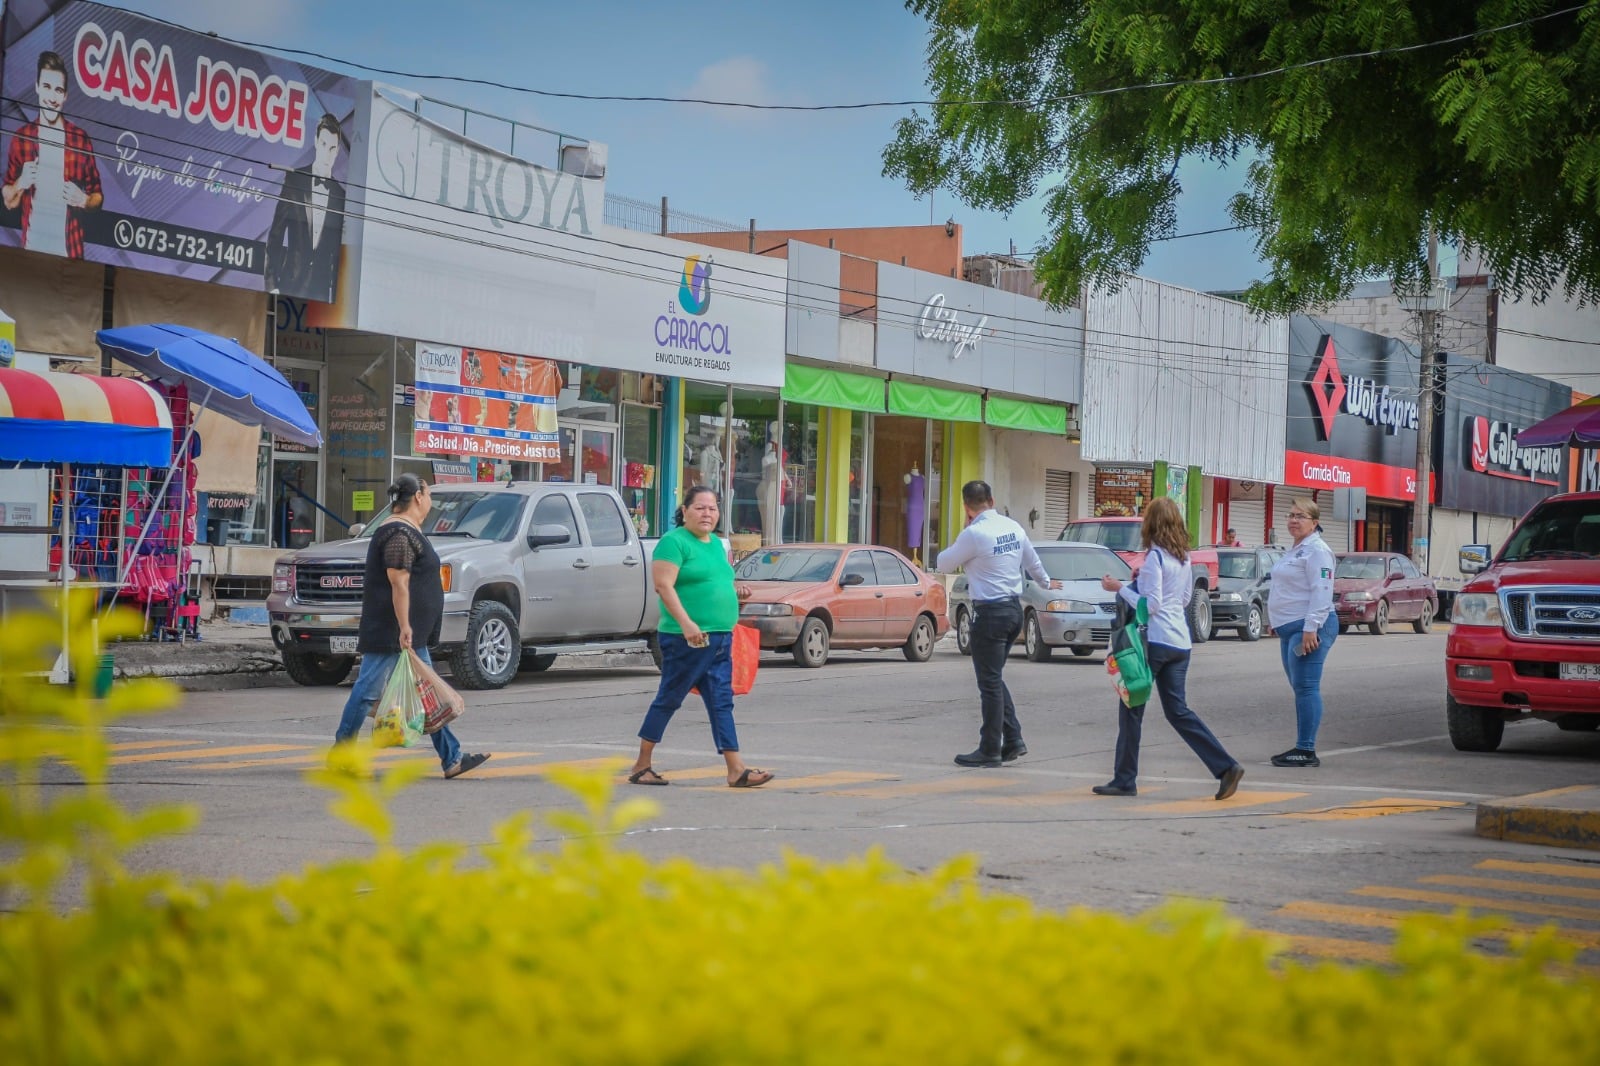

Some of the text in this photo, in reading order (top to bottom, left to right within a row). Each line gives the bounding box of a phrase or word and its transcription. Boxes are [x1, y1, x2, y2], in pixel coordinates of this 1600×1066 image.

[74, 23, 308, 147] CASA JORGE
[116, 131, 264, 204] Ropa de hombre
[429, 134, 592, 236] TROYA
[135, 226, 254, 268] 673-732-1401
[668, 301, 676, 314] EL
[654, 315, 731, 355] CARACOL
[655, 352, 731, 371] ENVOLTURA DE REGALOS
[1346, 374, 1379, 426] Wok
[428, 433, 457, 450] Salud
[463, 437, 479, 452] Día
[485, 439, 520, 457] Precios
[523, 443, 560, 458] Justos
[1302, 461, 1351, 484] Comida China
[993, 540, 1021, 555] PREVENTIVO
[996, 532, 1017, 545] AUXILIAR
[320, 575, 364, 588] GMC
[1574, 610, 1596, 619] Ford
